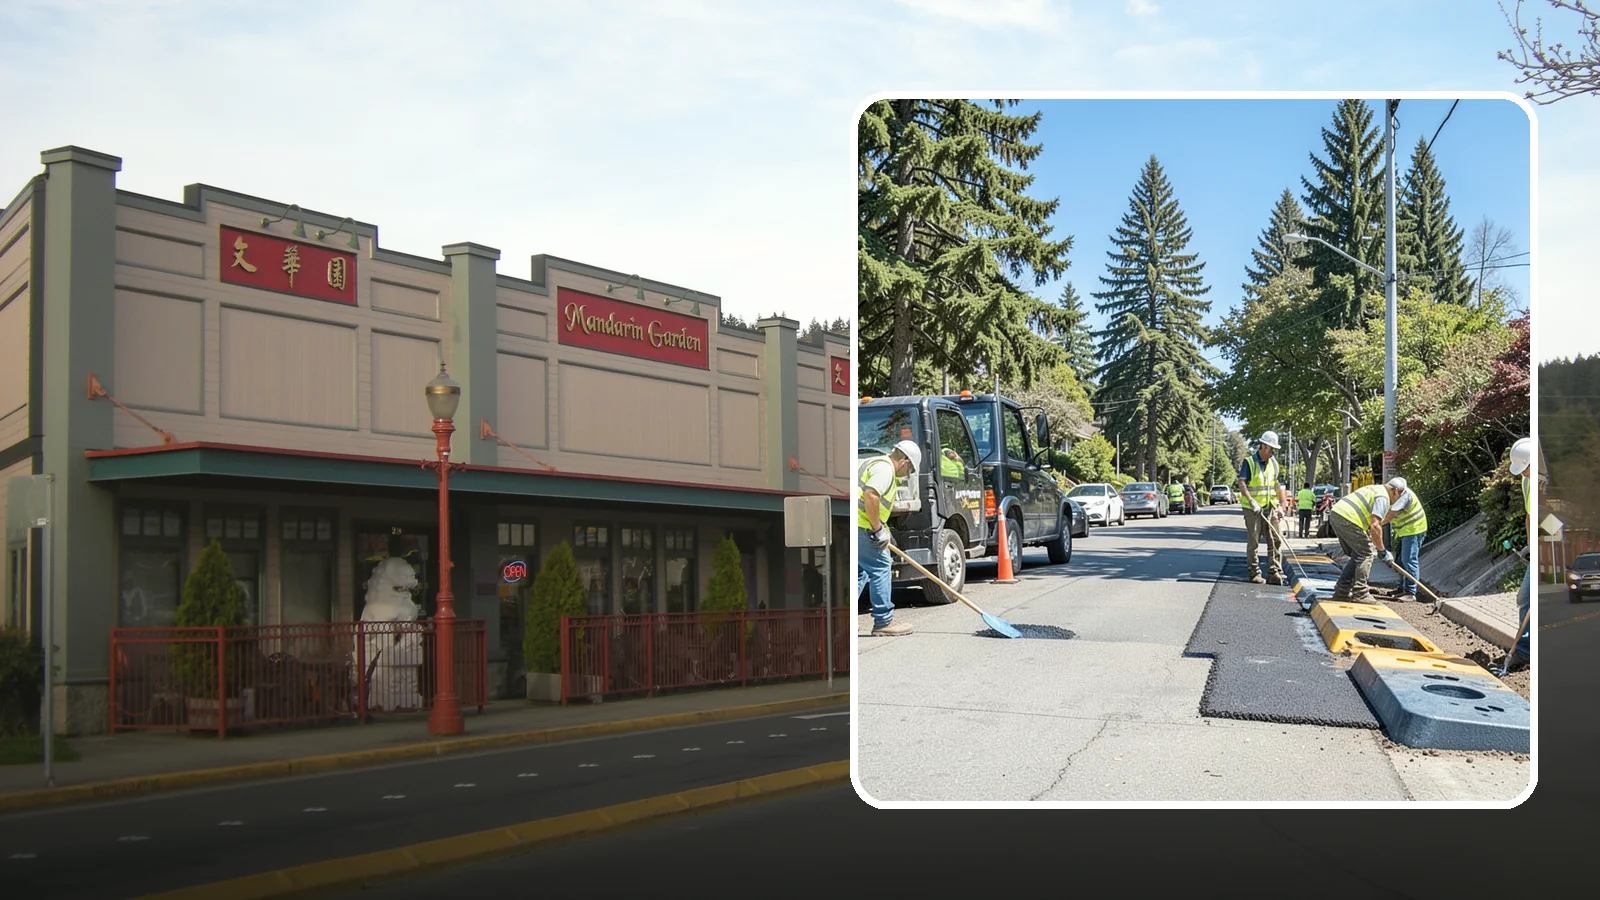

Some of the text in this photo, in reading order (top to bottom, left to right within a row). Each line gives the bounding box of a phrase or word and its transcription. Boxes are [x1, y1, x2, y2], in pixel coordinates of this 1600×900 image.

[230, 235, 347, 292] 文華園
[564, 302, 702, 352] Mandarin Garden
[834, 362, 846, 387] 文
[503, 565, 527, 578] OPEN
